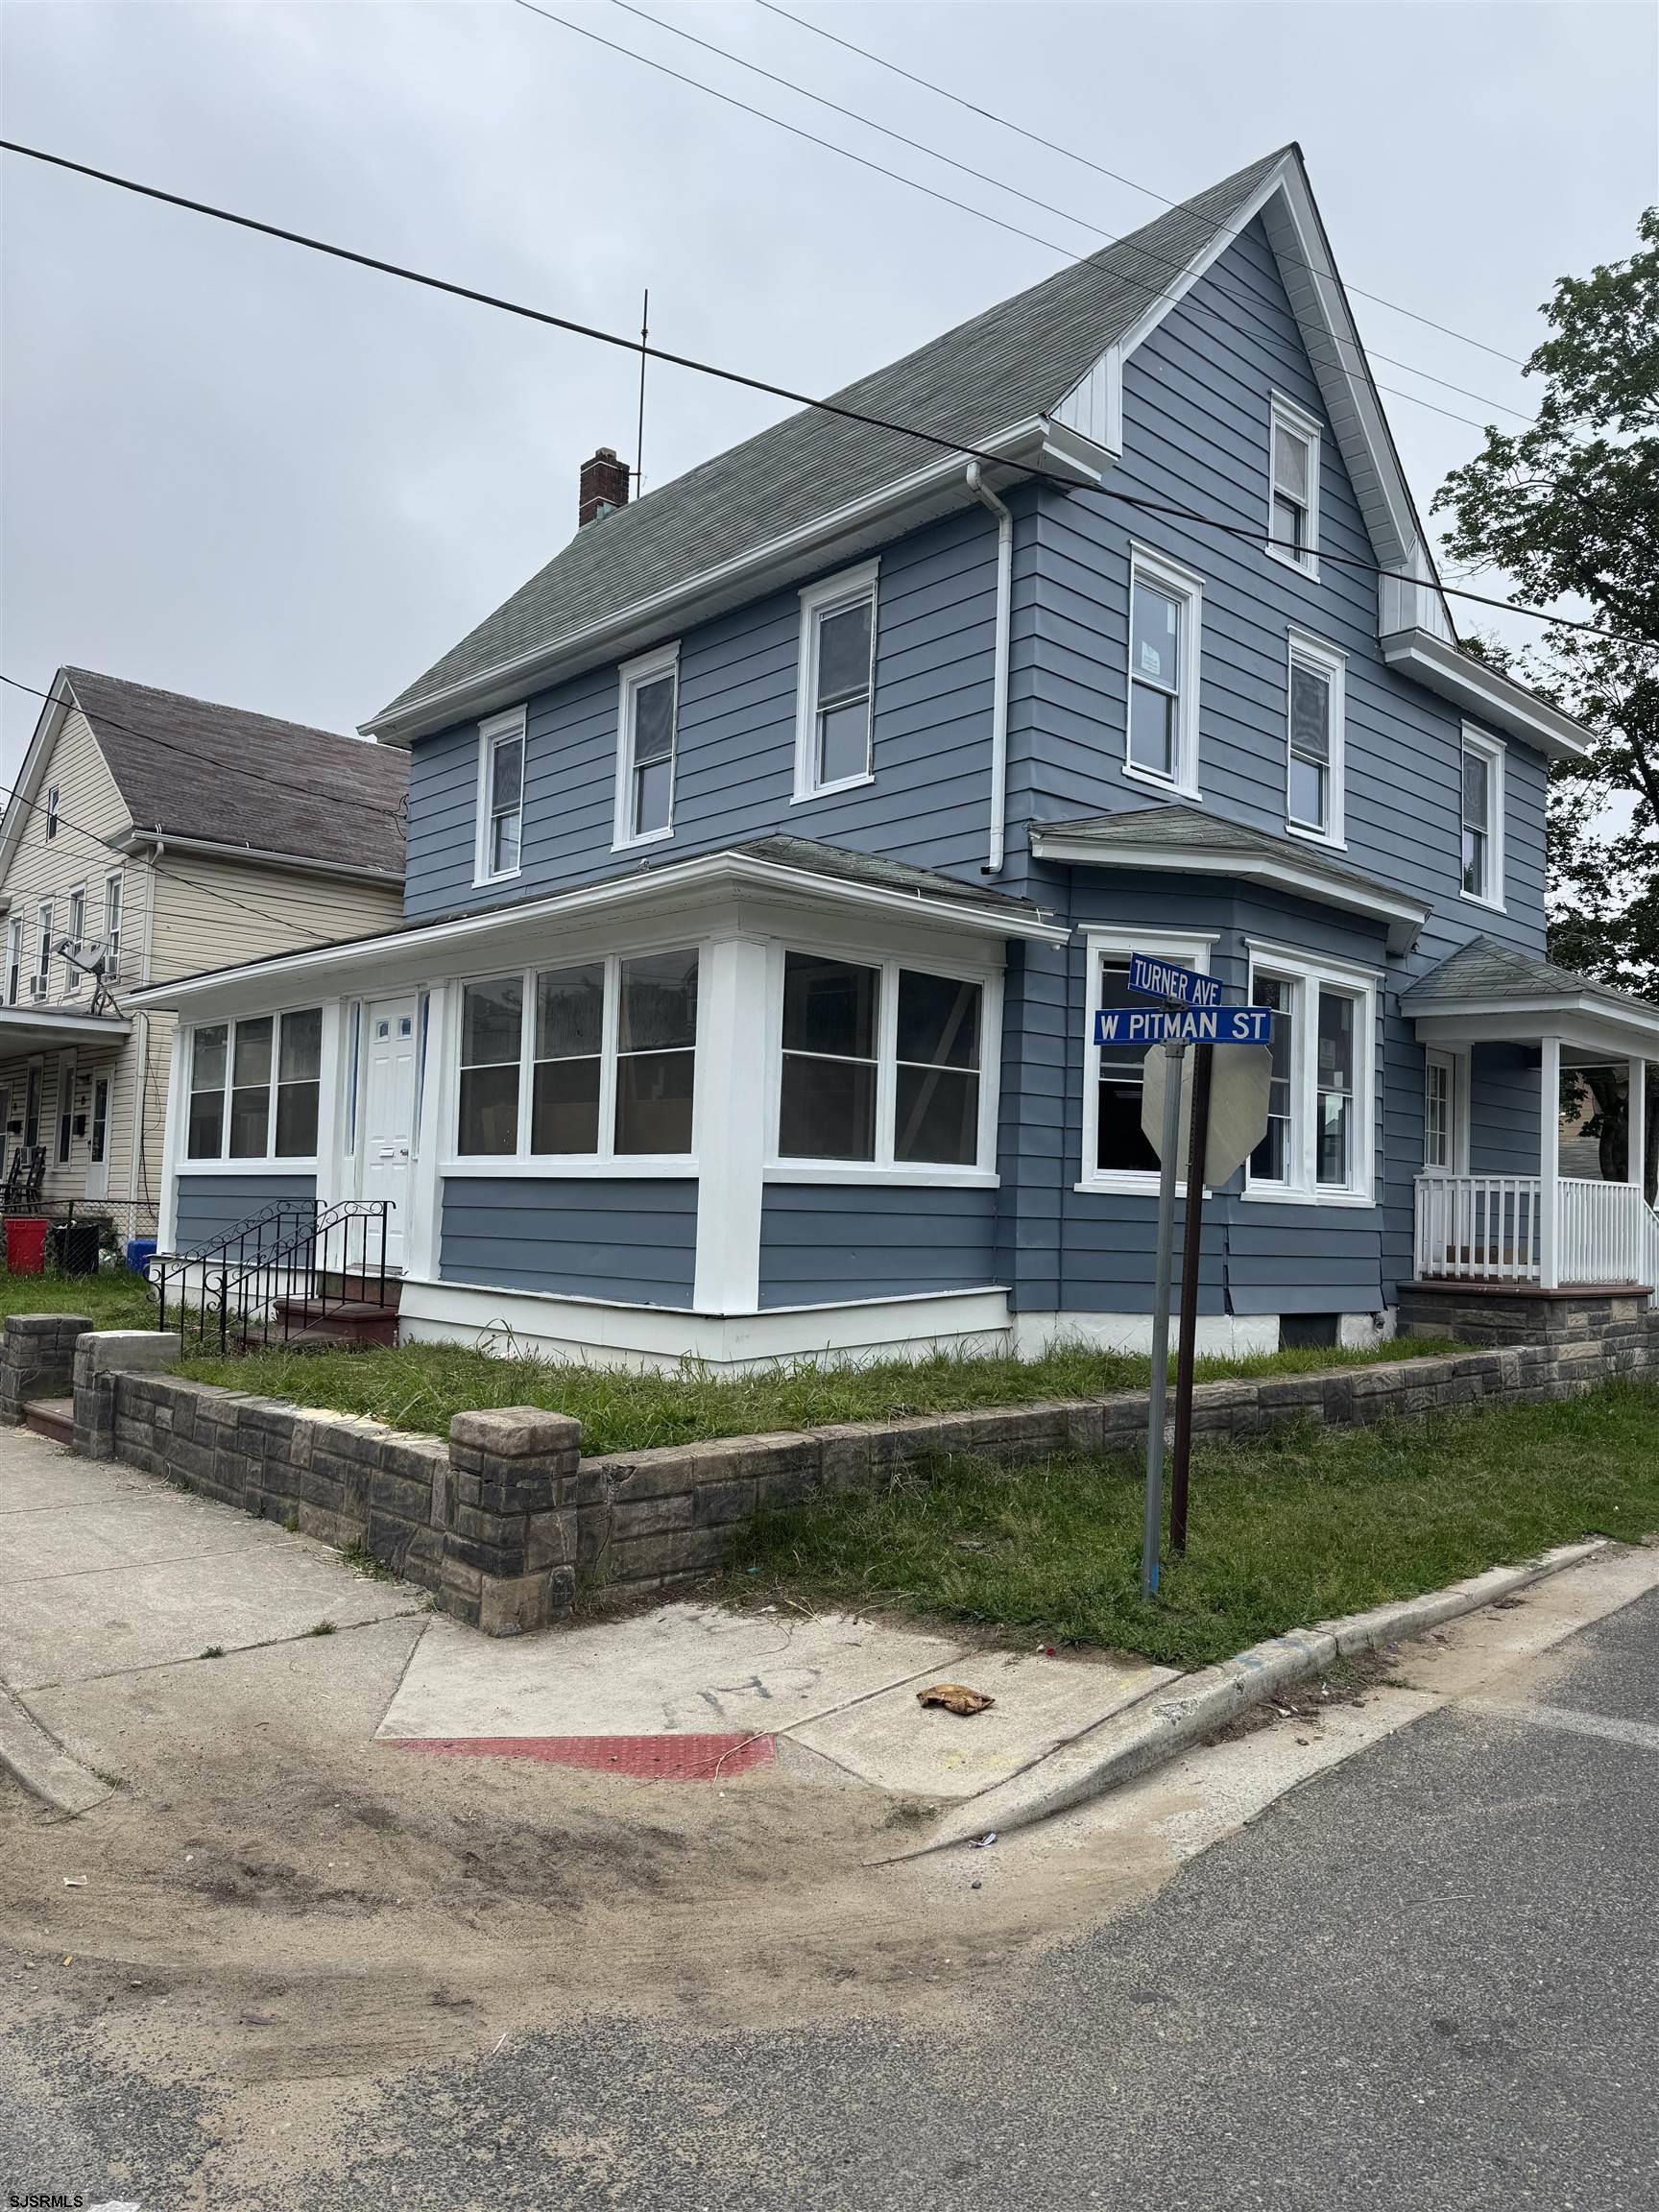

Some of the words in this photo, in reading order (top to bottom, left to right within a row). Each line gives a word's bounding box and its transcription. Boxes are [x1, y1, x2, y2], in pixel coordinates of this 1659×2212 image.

[1135, 959, 1189, 1000] TURNER
[1192, 978, 1219, 1005] AVE
[1101, 1015, 1119, 1039] W
[1129, 1012, 1217, 1039] PITMAN
[1232, 1012, 1266, 1039] ST
